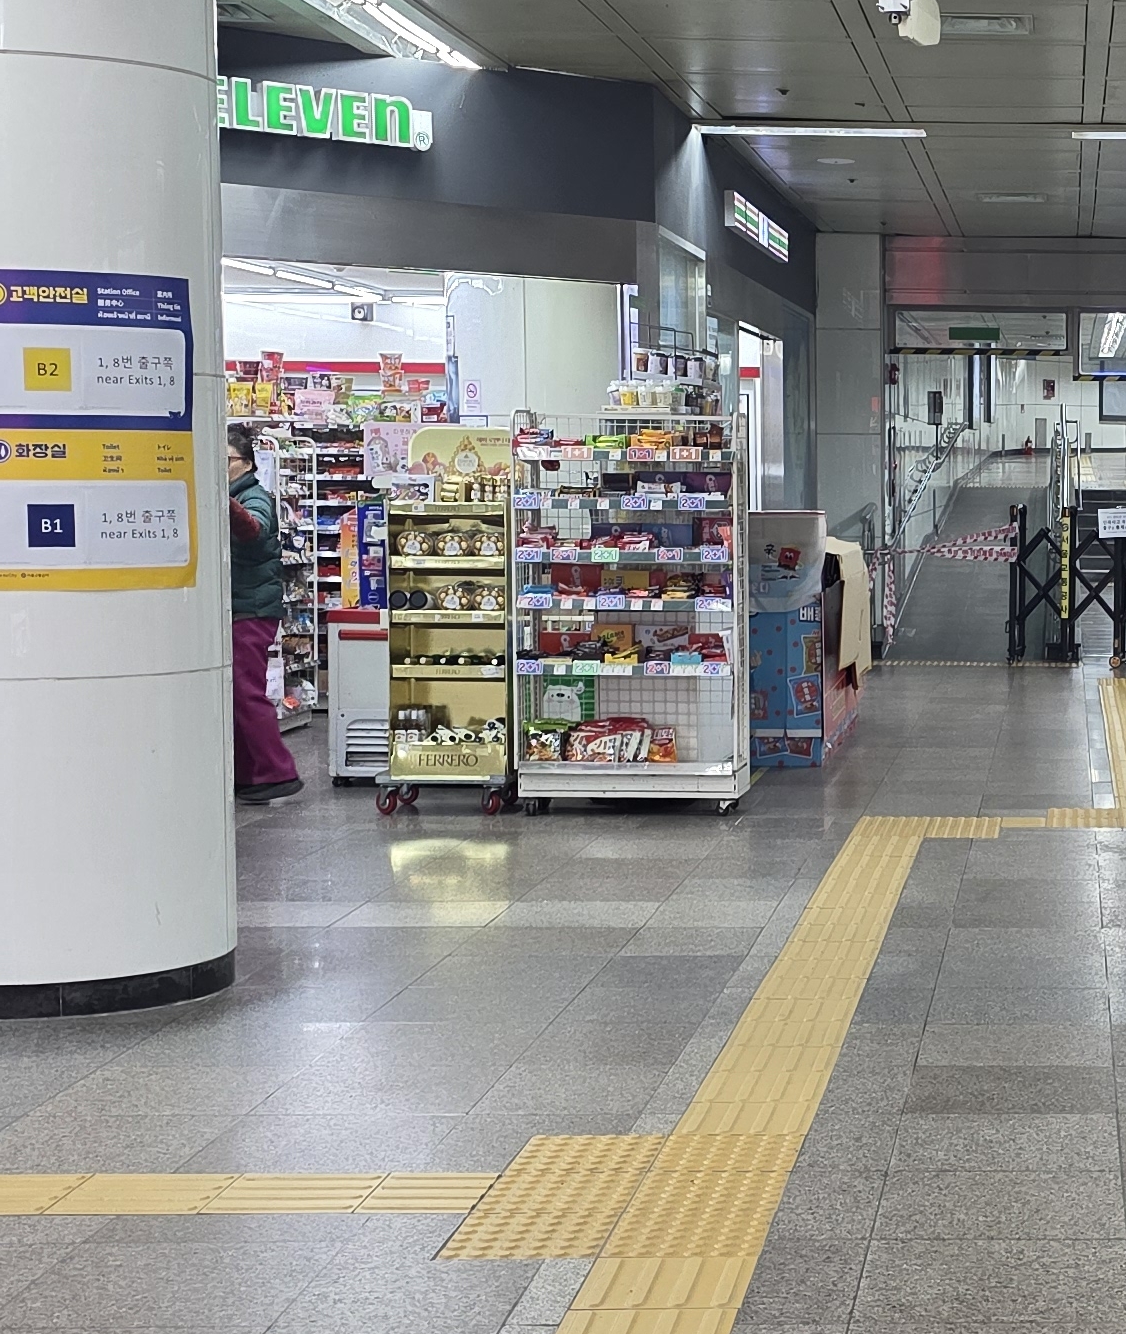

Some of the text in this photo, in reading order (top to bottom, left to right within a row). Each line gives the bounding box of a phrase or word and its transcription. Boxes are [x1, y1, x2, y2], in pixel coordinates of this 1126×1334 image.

[9, 286, 88, 304] 고객안전실
[97, 287, 140, 296] Station Office
[112, 356, 133, 369] 8번
[137, 356, 174, 371] 출구쪽
[37, 362, 59, 377] B2
[96, 375, 124, 385] near
[128, 373, 155, 385] Exits
[169, 375, 175, 386] 8
[14, 442, 68, 459] 화장실
[566, 447, 588, 458] 1+1
[631, 449, 652, 459] 1+1
[673, 448, 696, 459] 1+1
[514, 497, 537, 507] 2+1
[623, 498, 646, 508] 2+1
[681, 498, 704, 508] 2+1
[116, 510, 137, 524] 8번
[141, 510, 177, 525] 출구쪽
[41, 518, 63, 533] B1
[100, 530, 128, 540] near
[132, 529, 157, 540] Exits
[172, 529, 179, 540] 8
[517, 550, 540, 560] 2+1
[594, 550, 618, 560] 2+1
[703, 550, 726, 560] 2+1
[527, 596, 548, 606] 2+1
[600, 596, 624, 607] 2+1
[518, 662, 541, 672] 2+1
[575, 663, 598, 673] 2+1
[417, 753, 478, 768] FERRERO
